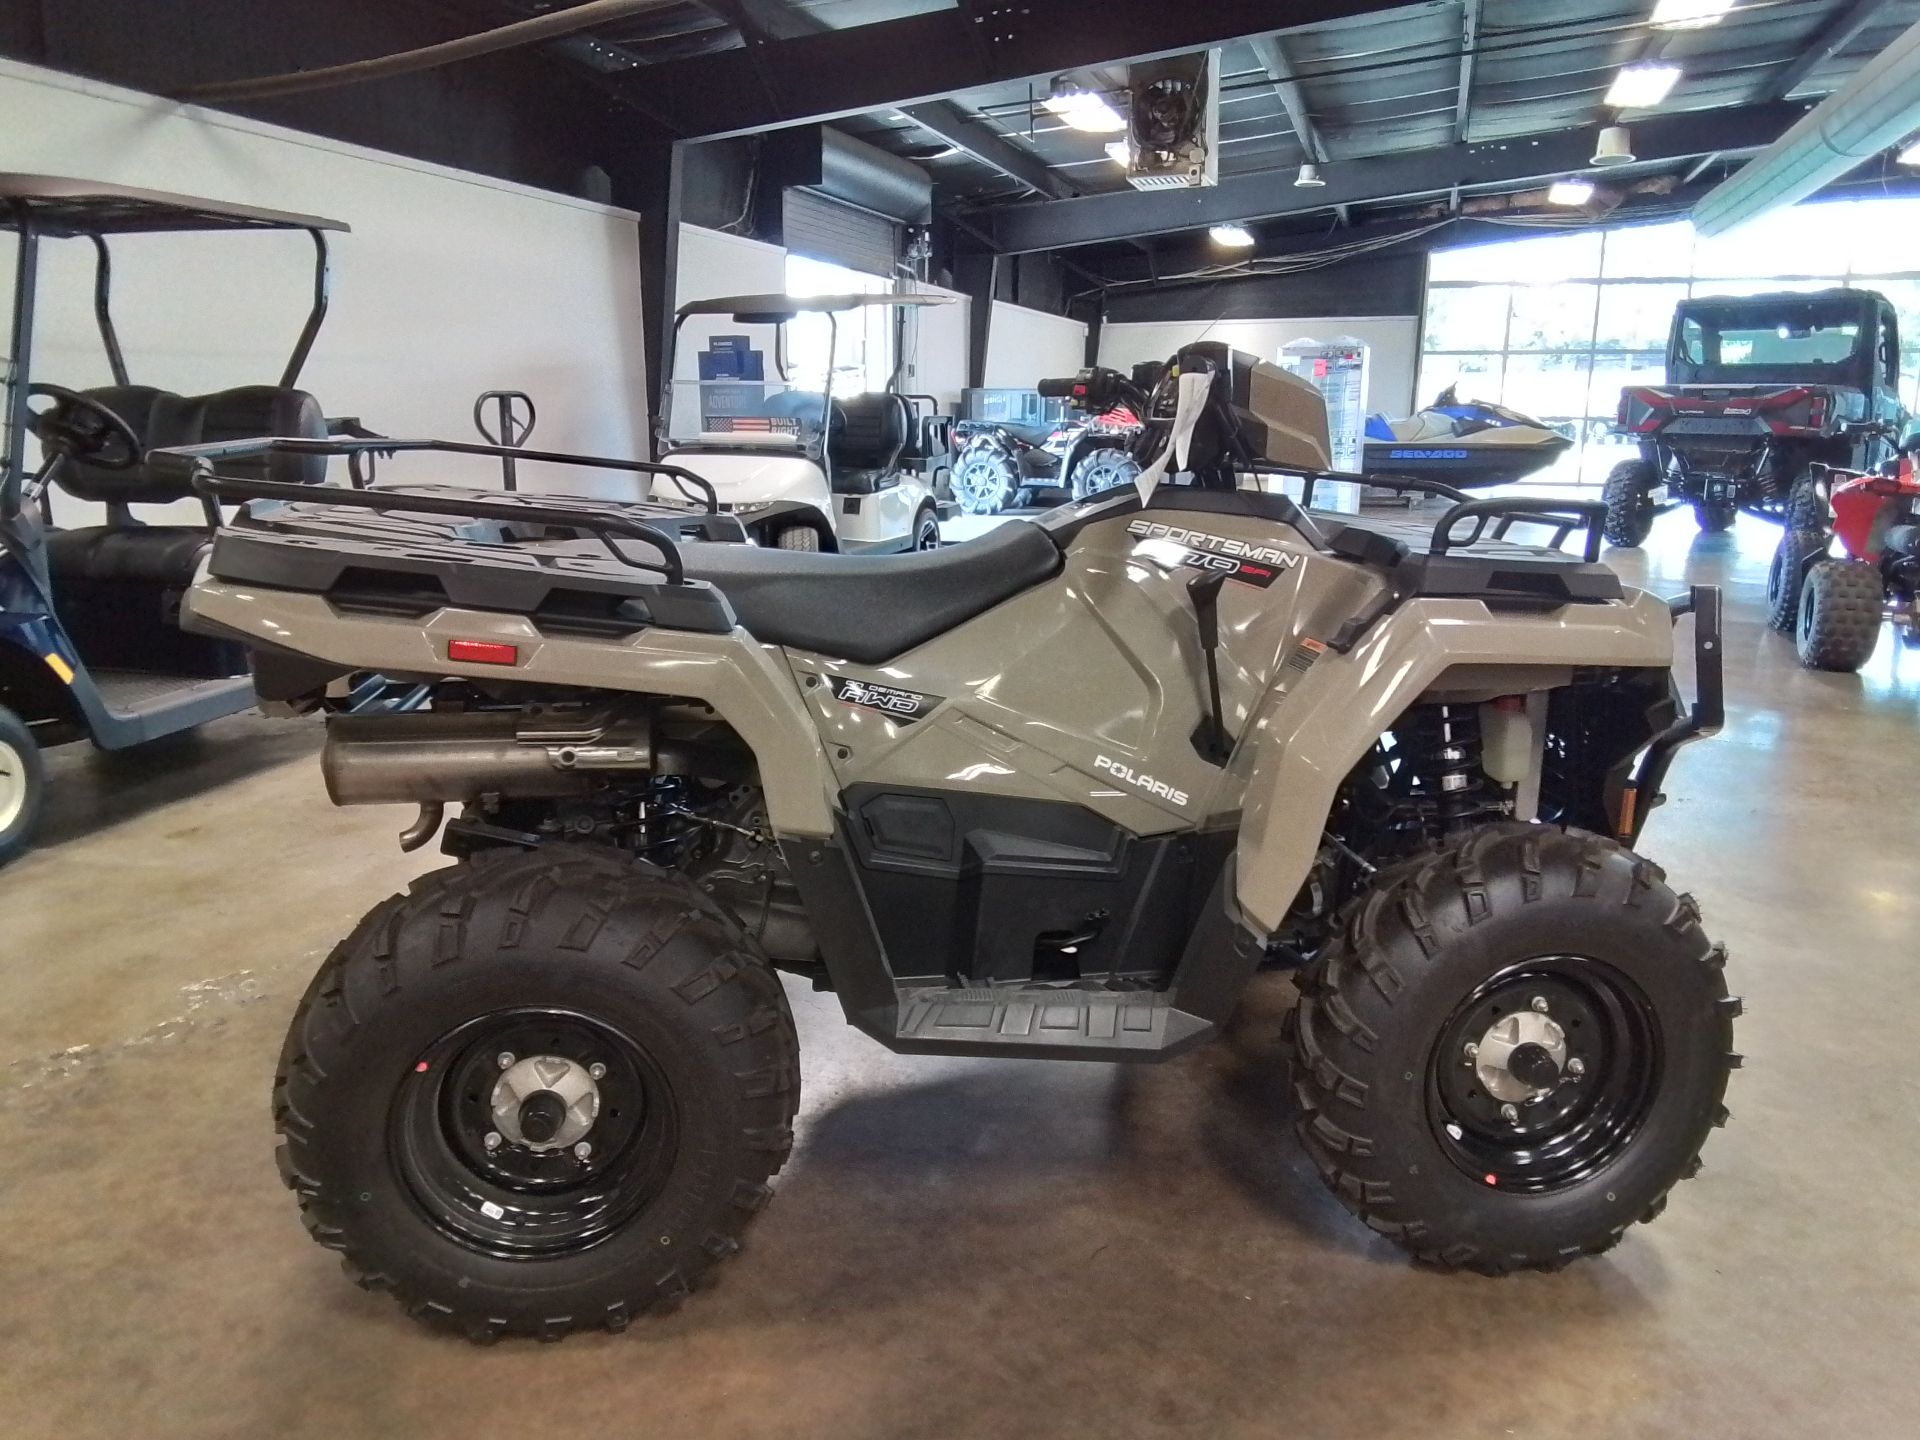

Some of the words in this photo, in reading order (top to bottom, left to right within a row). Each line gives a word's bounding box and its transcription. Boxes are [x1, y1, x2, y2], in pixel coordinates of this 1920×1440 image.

[770, 417, 797, 426] BUILT
[1126, 519, 1300, 568] SPORTSMAN
[838, 686, 919, 713] AWD
[868, 685, 923, 700] DEMAND
[1093, 754, 1189, 806] POLARIS
